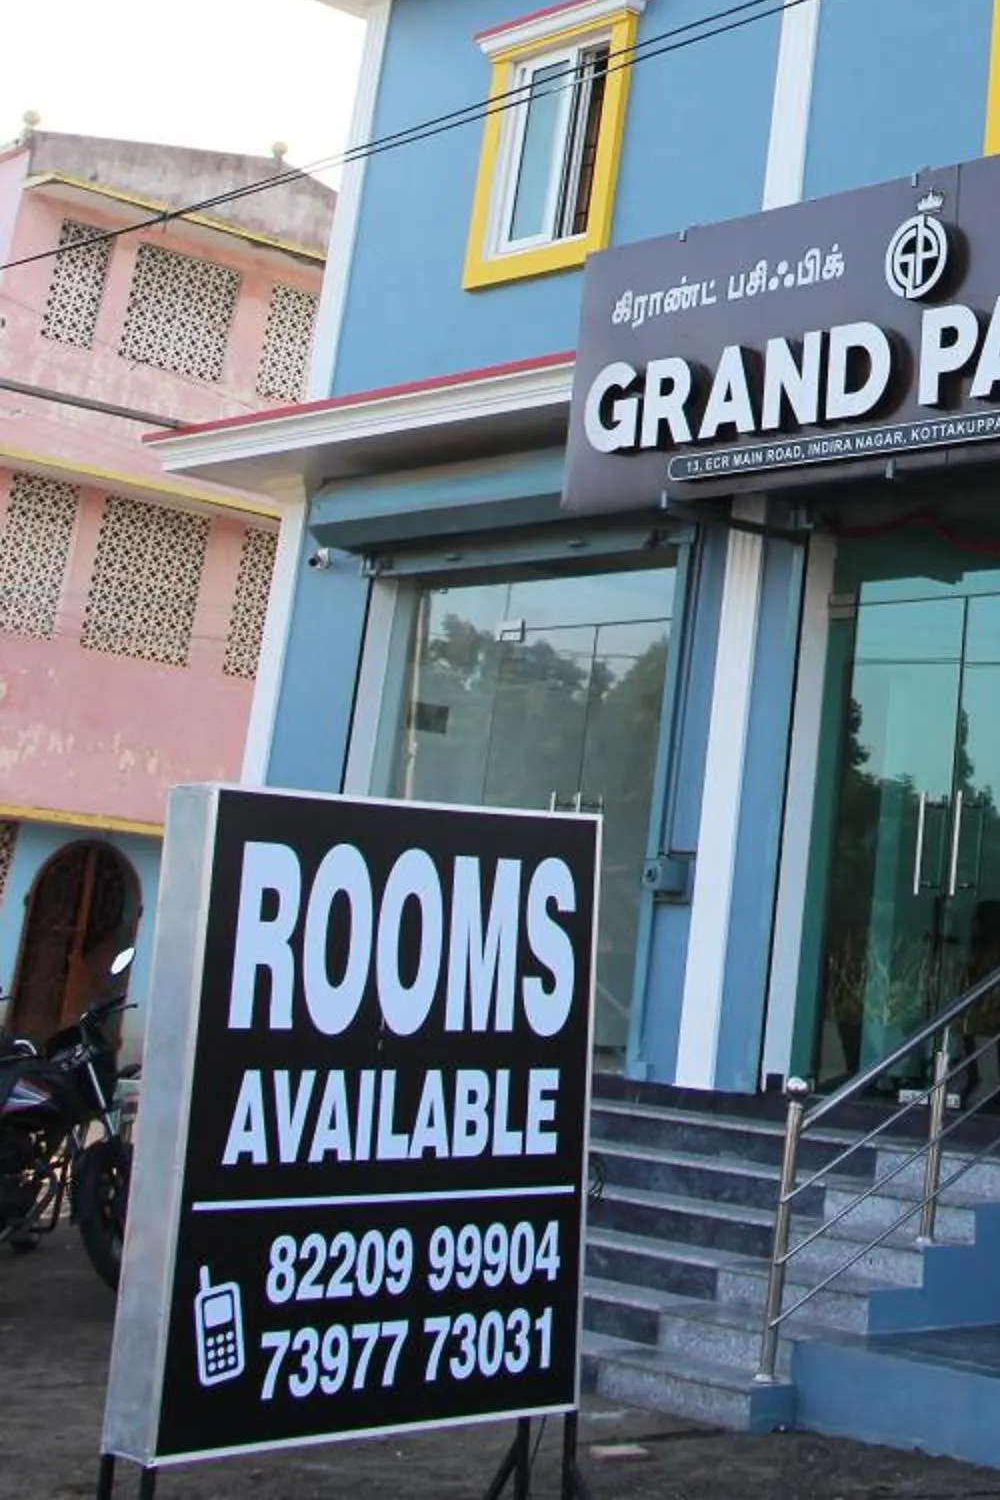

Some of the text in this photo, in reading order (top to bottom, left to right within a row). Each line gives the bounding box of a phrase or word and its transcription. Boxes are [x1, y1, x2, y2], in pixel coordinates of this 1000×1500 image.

[584, 322, 891, 453] GRAND
[705, 458, 729, 470] ECR
[733, 453, 763, 467] MAIN
[767, 446, 805, 462] ROAD,
[807, 439, 850, 456] INDIRA
[228, 841, 576, 1037] ROOMS
[222, 1068, 559, 1165] AVAILABLE
[266, 1220, 560, 1303] 82209 99904
[260, 1307, 552, 1399] 73977 73031
